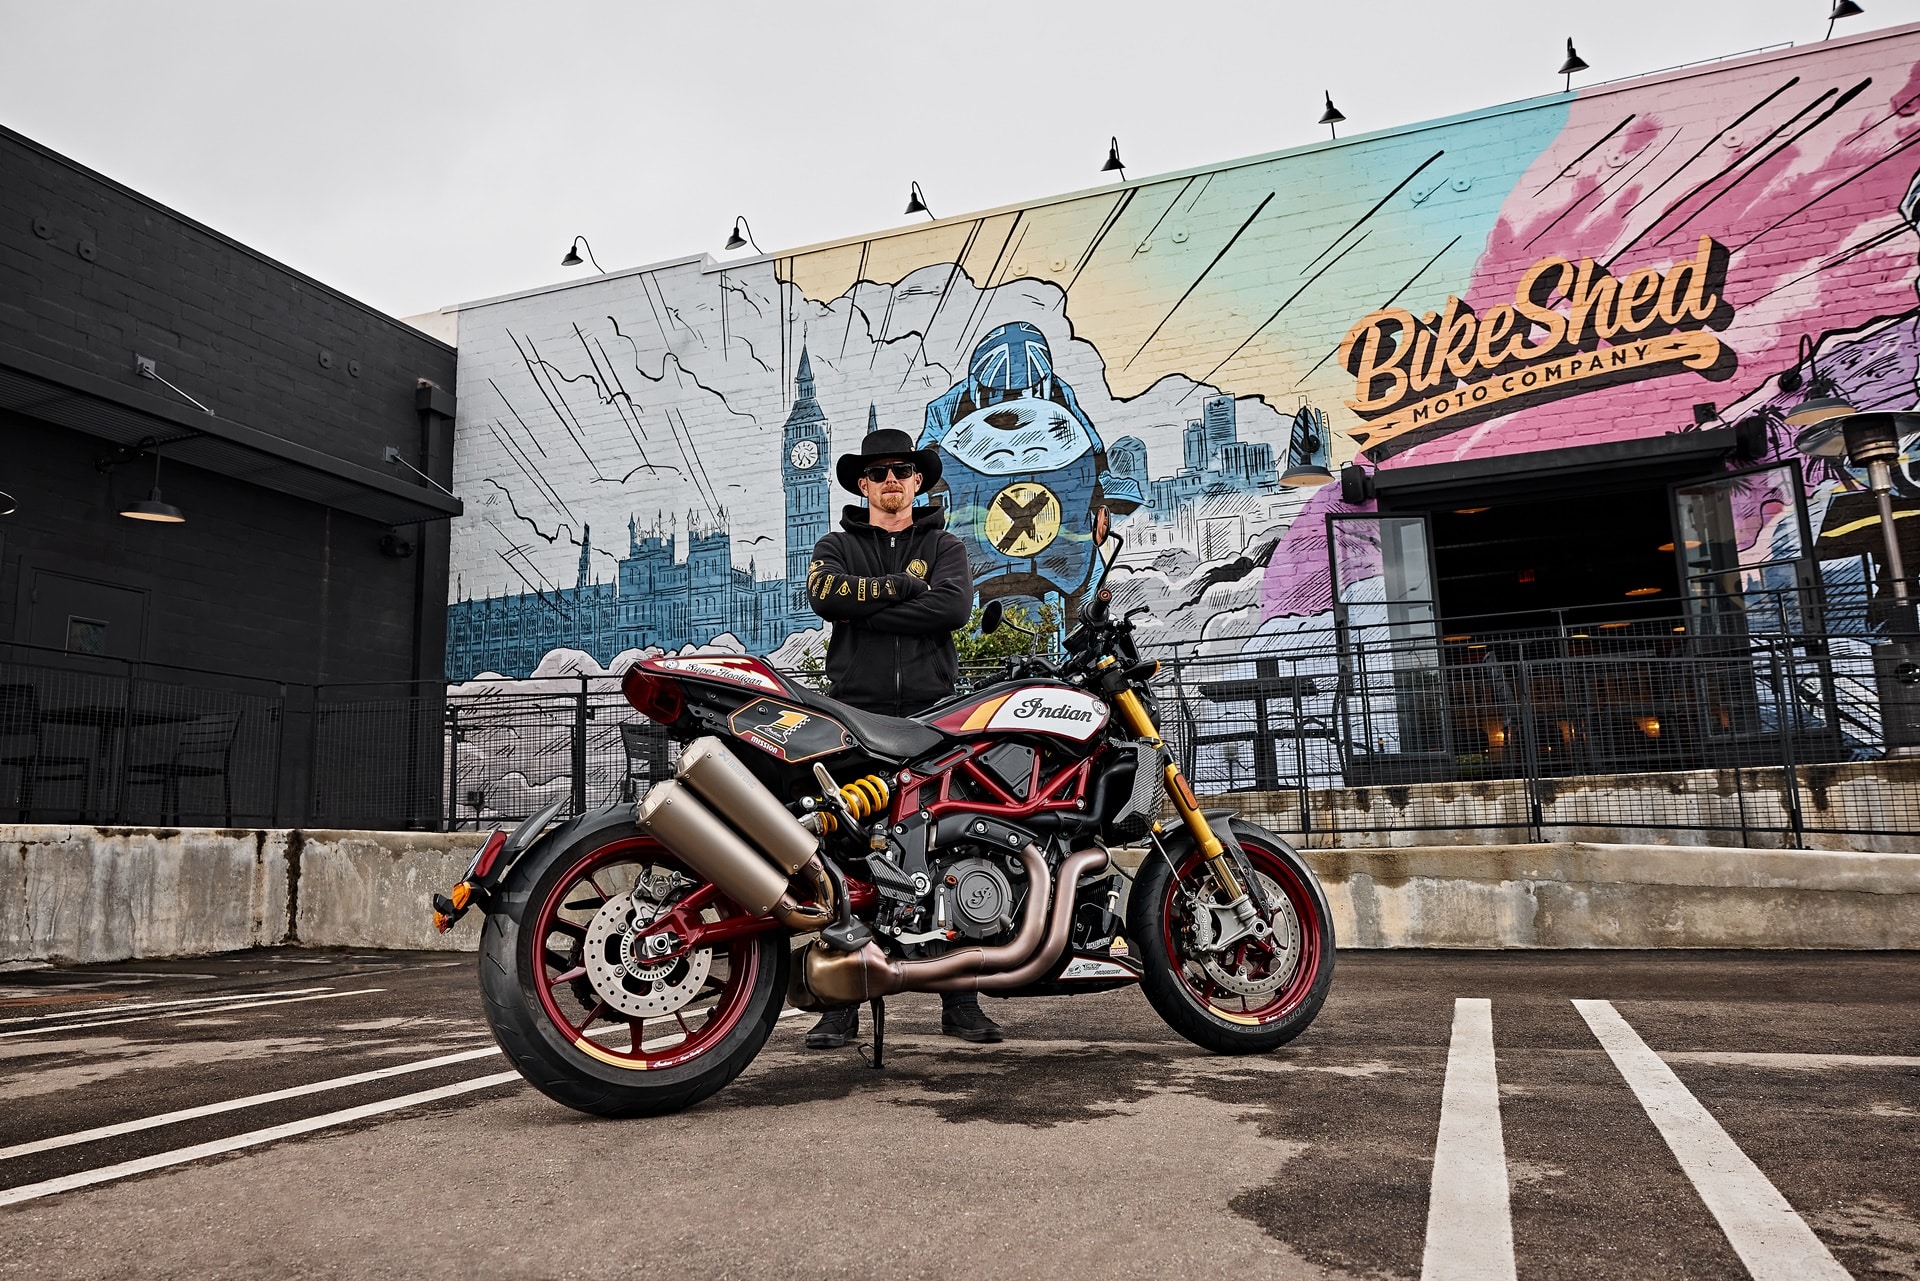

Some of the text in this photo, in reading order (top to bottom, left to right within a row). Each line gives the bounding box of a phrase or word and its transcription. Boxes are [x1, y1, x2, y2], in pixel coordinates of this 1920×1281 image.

[1413, 344, 1650, 424] MOTO COMPANY
[685, 663, 763, 686] Super Hooligan
[1013, 697, 1093, 723] Indian
[1268, 998, 1312, 1031] SPORTEC
